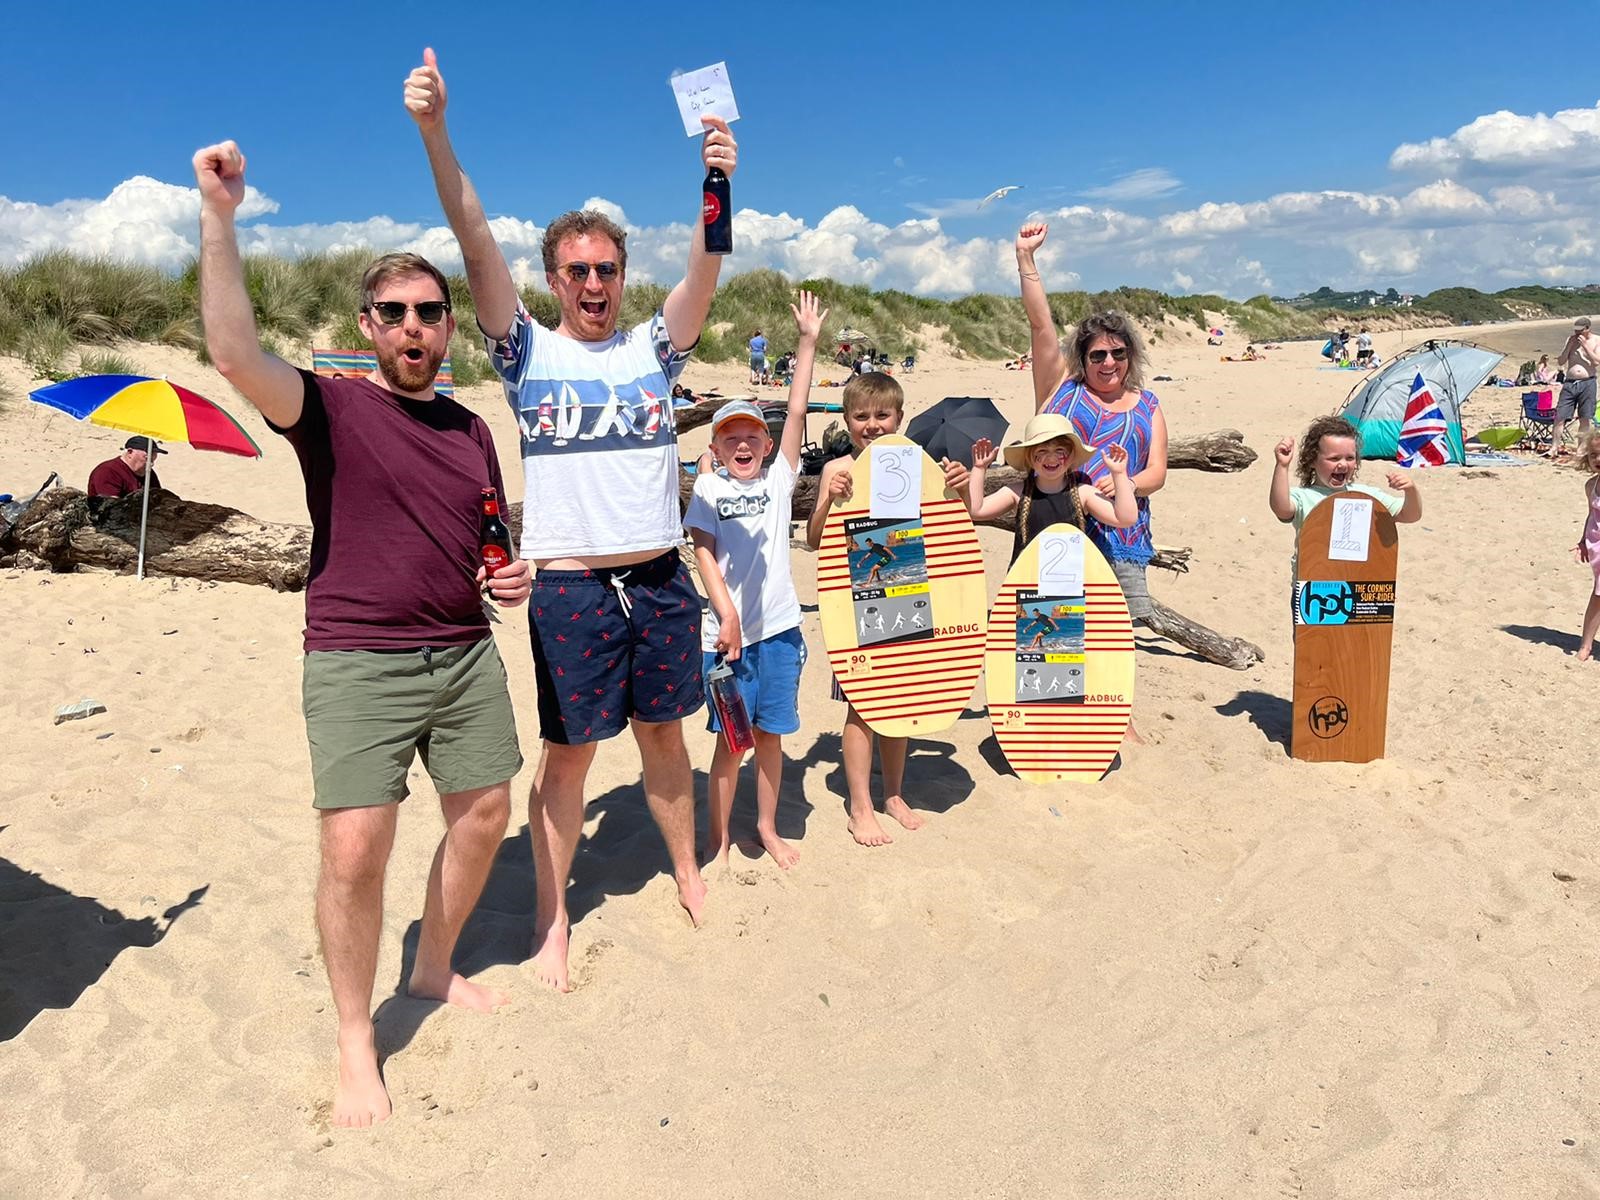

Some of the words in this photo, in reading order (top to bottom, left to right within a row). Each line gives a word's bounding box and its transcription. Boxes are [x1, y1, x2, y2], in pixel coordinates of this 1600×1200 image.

[855, 520, 879, 528] RADBUG
[1355, 583, 1366, 593] THE
[1367, 583, 1394, 593] CORNISH
[1360, 592, 1396, 602] SURF-RIDER
[934, 623, 979, 636] RADBUG
[851, 654, 866, 665] 90
[1083, 694, 1124, 703] RADBUG
[1007, 710, 1021, 719] 90
